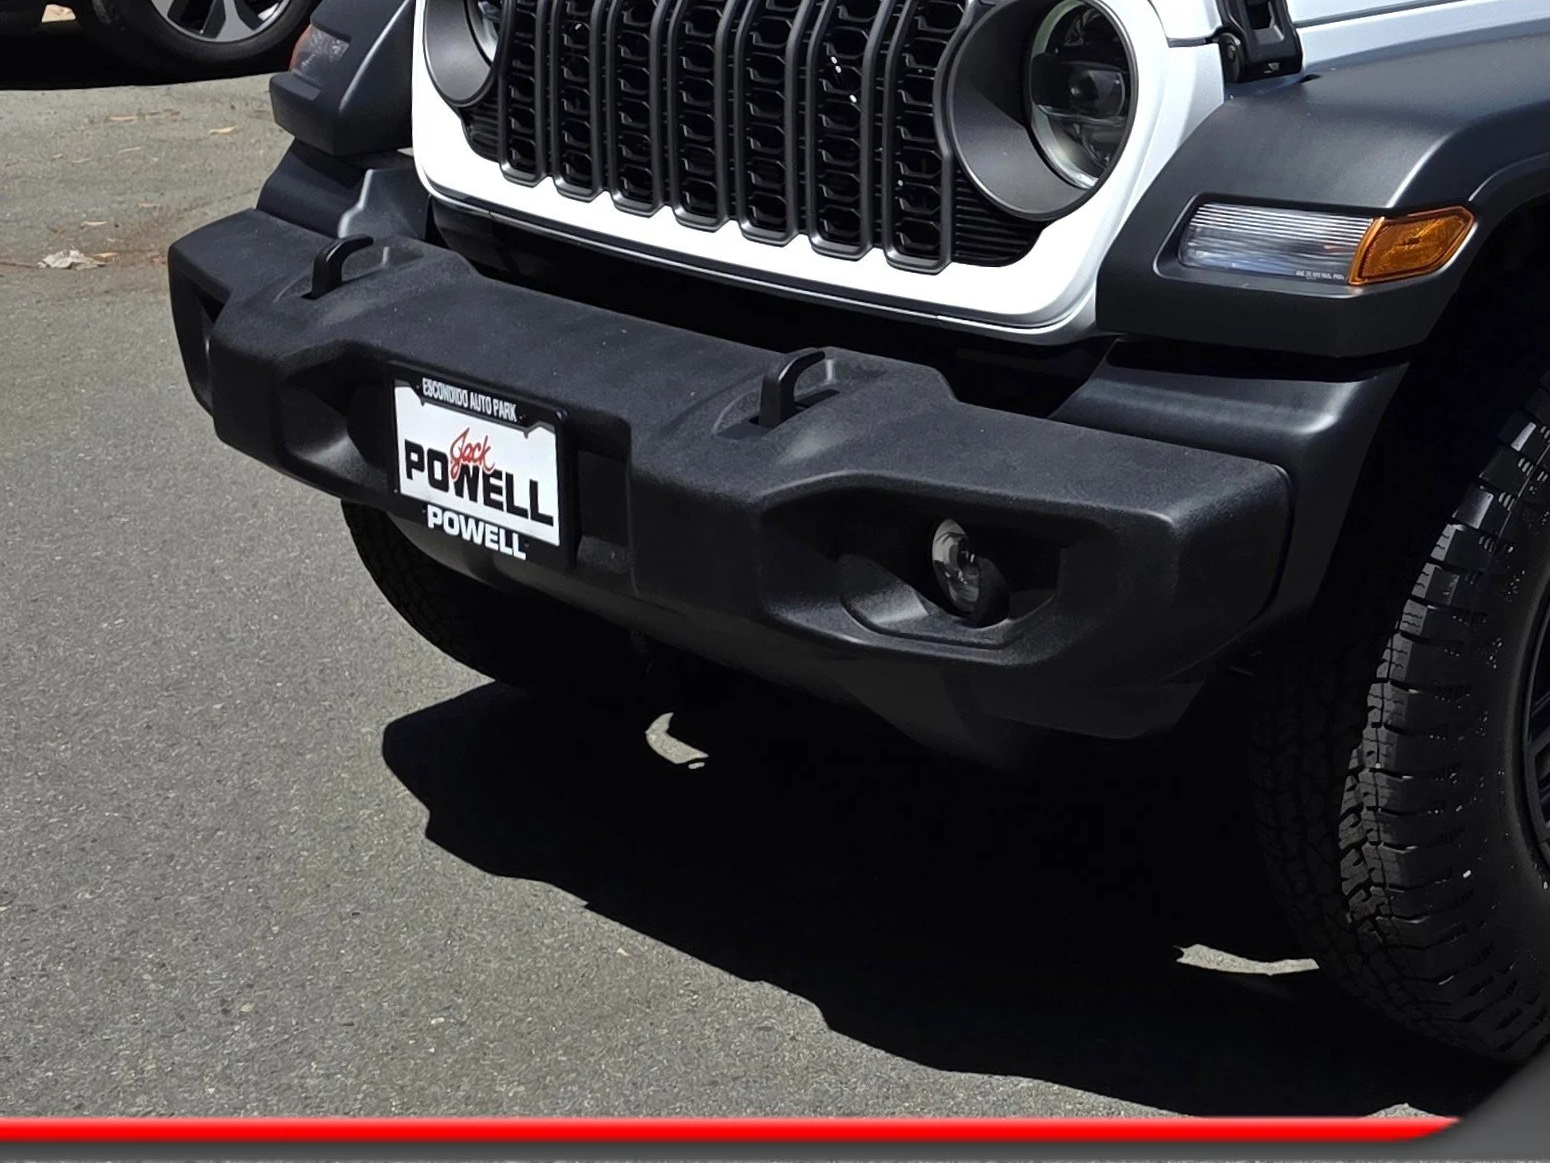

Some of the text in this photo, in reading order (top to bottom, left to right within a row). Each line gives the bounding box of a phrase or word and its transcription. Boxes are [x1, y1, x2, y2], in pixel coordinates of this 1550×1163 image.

[422, 377, 518, 422] ESCONDIDO AUTO PARK
[450, 427, 495, 480] Jack
[404, 438, 555, 527] POWELL
[427, 504, 527, 560] POWELL
